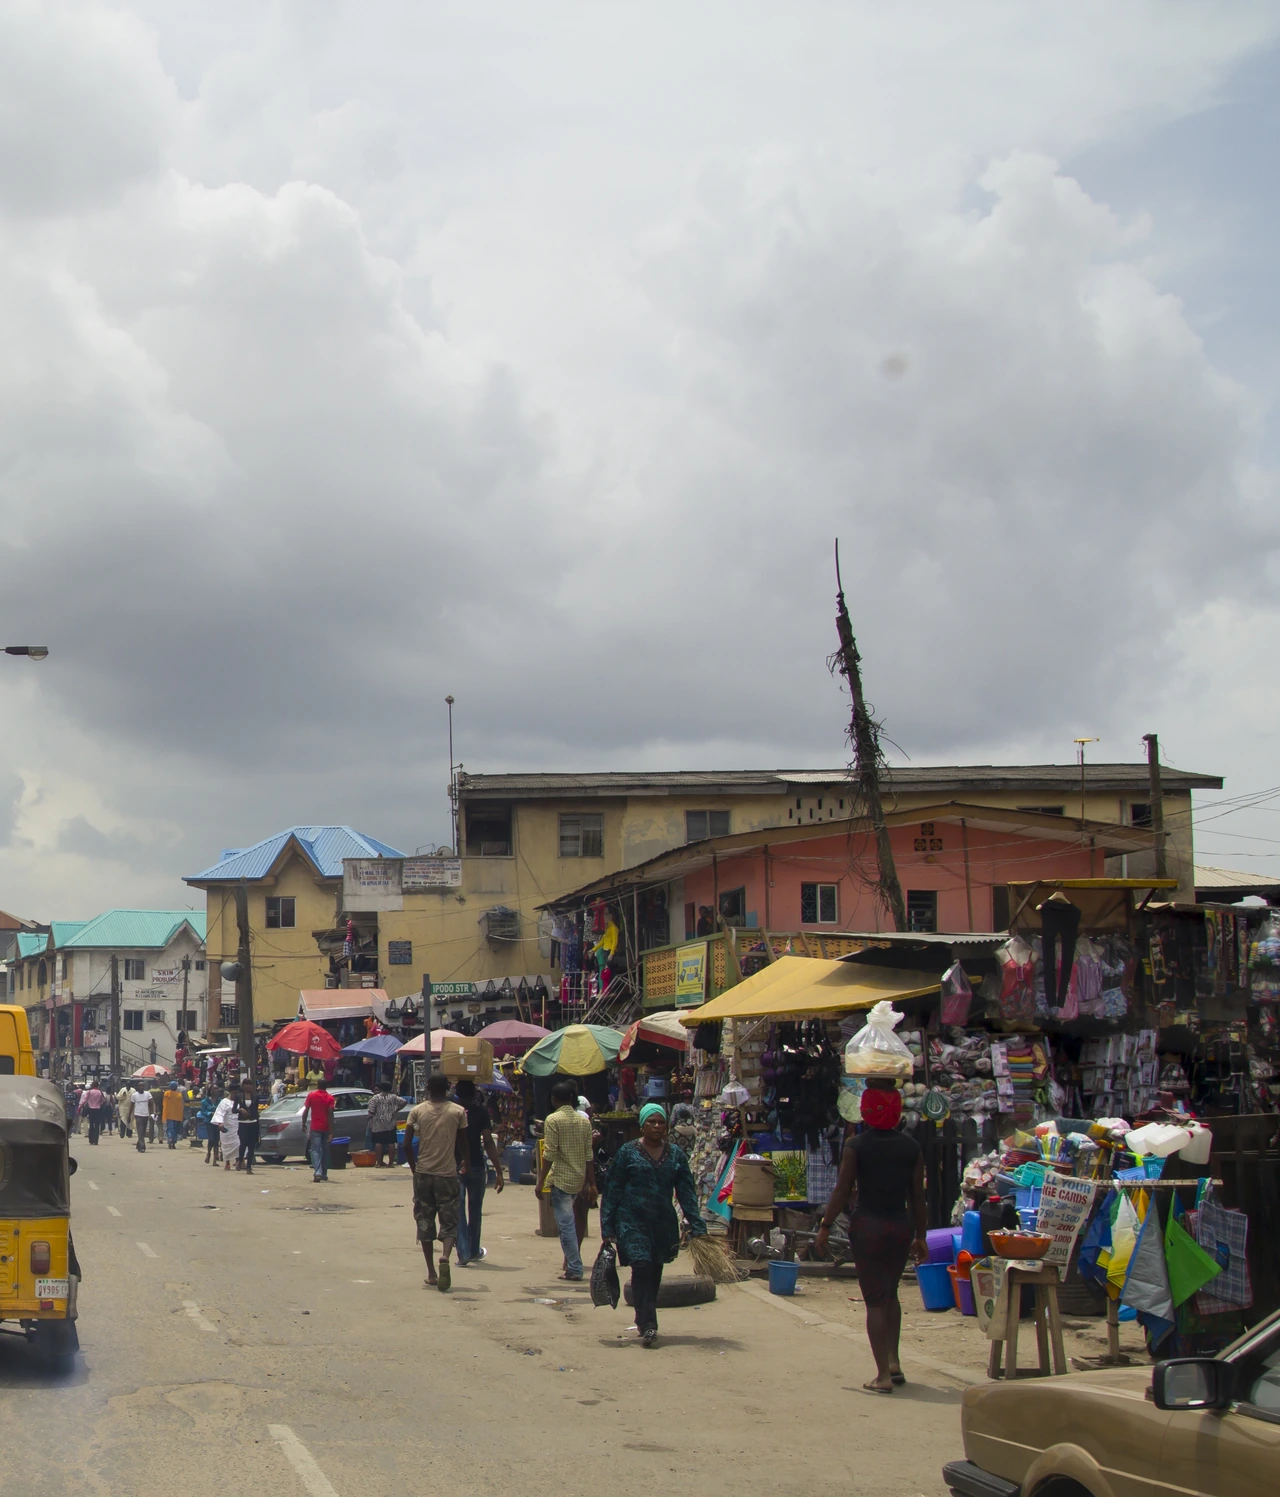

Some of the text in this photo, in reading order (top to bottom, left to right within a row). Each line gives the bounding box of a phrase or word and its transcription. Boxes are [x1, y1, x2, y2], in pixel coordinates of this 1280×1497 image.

[433, 983, 469, 993] IPODO STR
[1061, 1179, 1092, 1194] YOUR
[1058, 1189, 1088, 1205] CARDS
